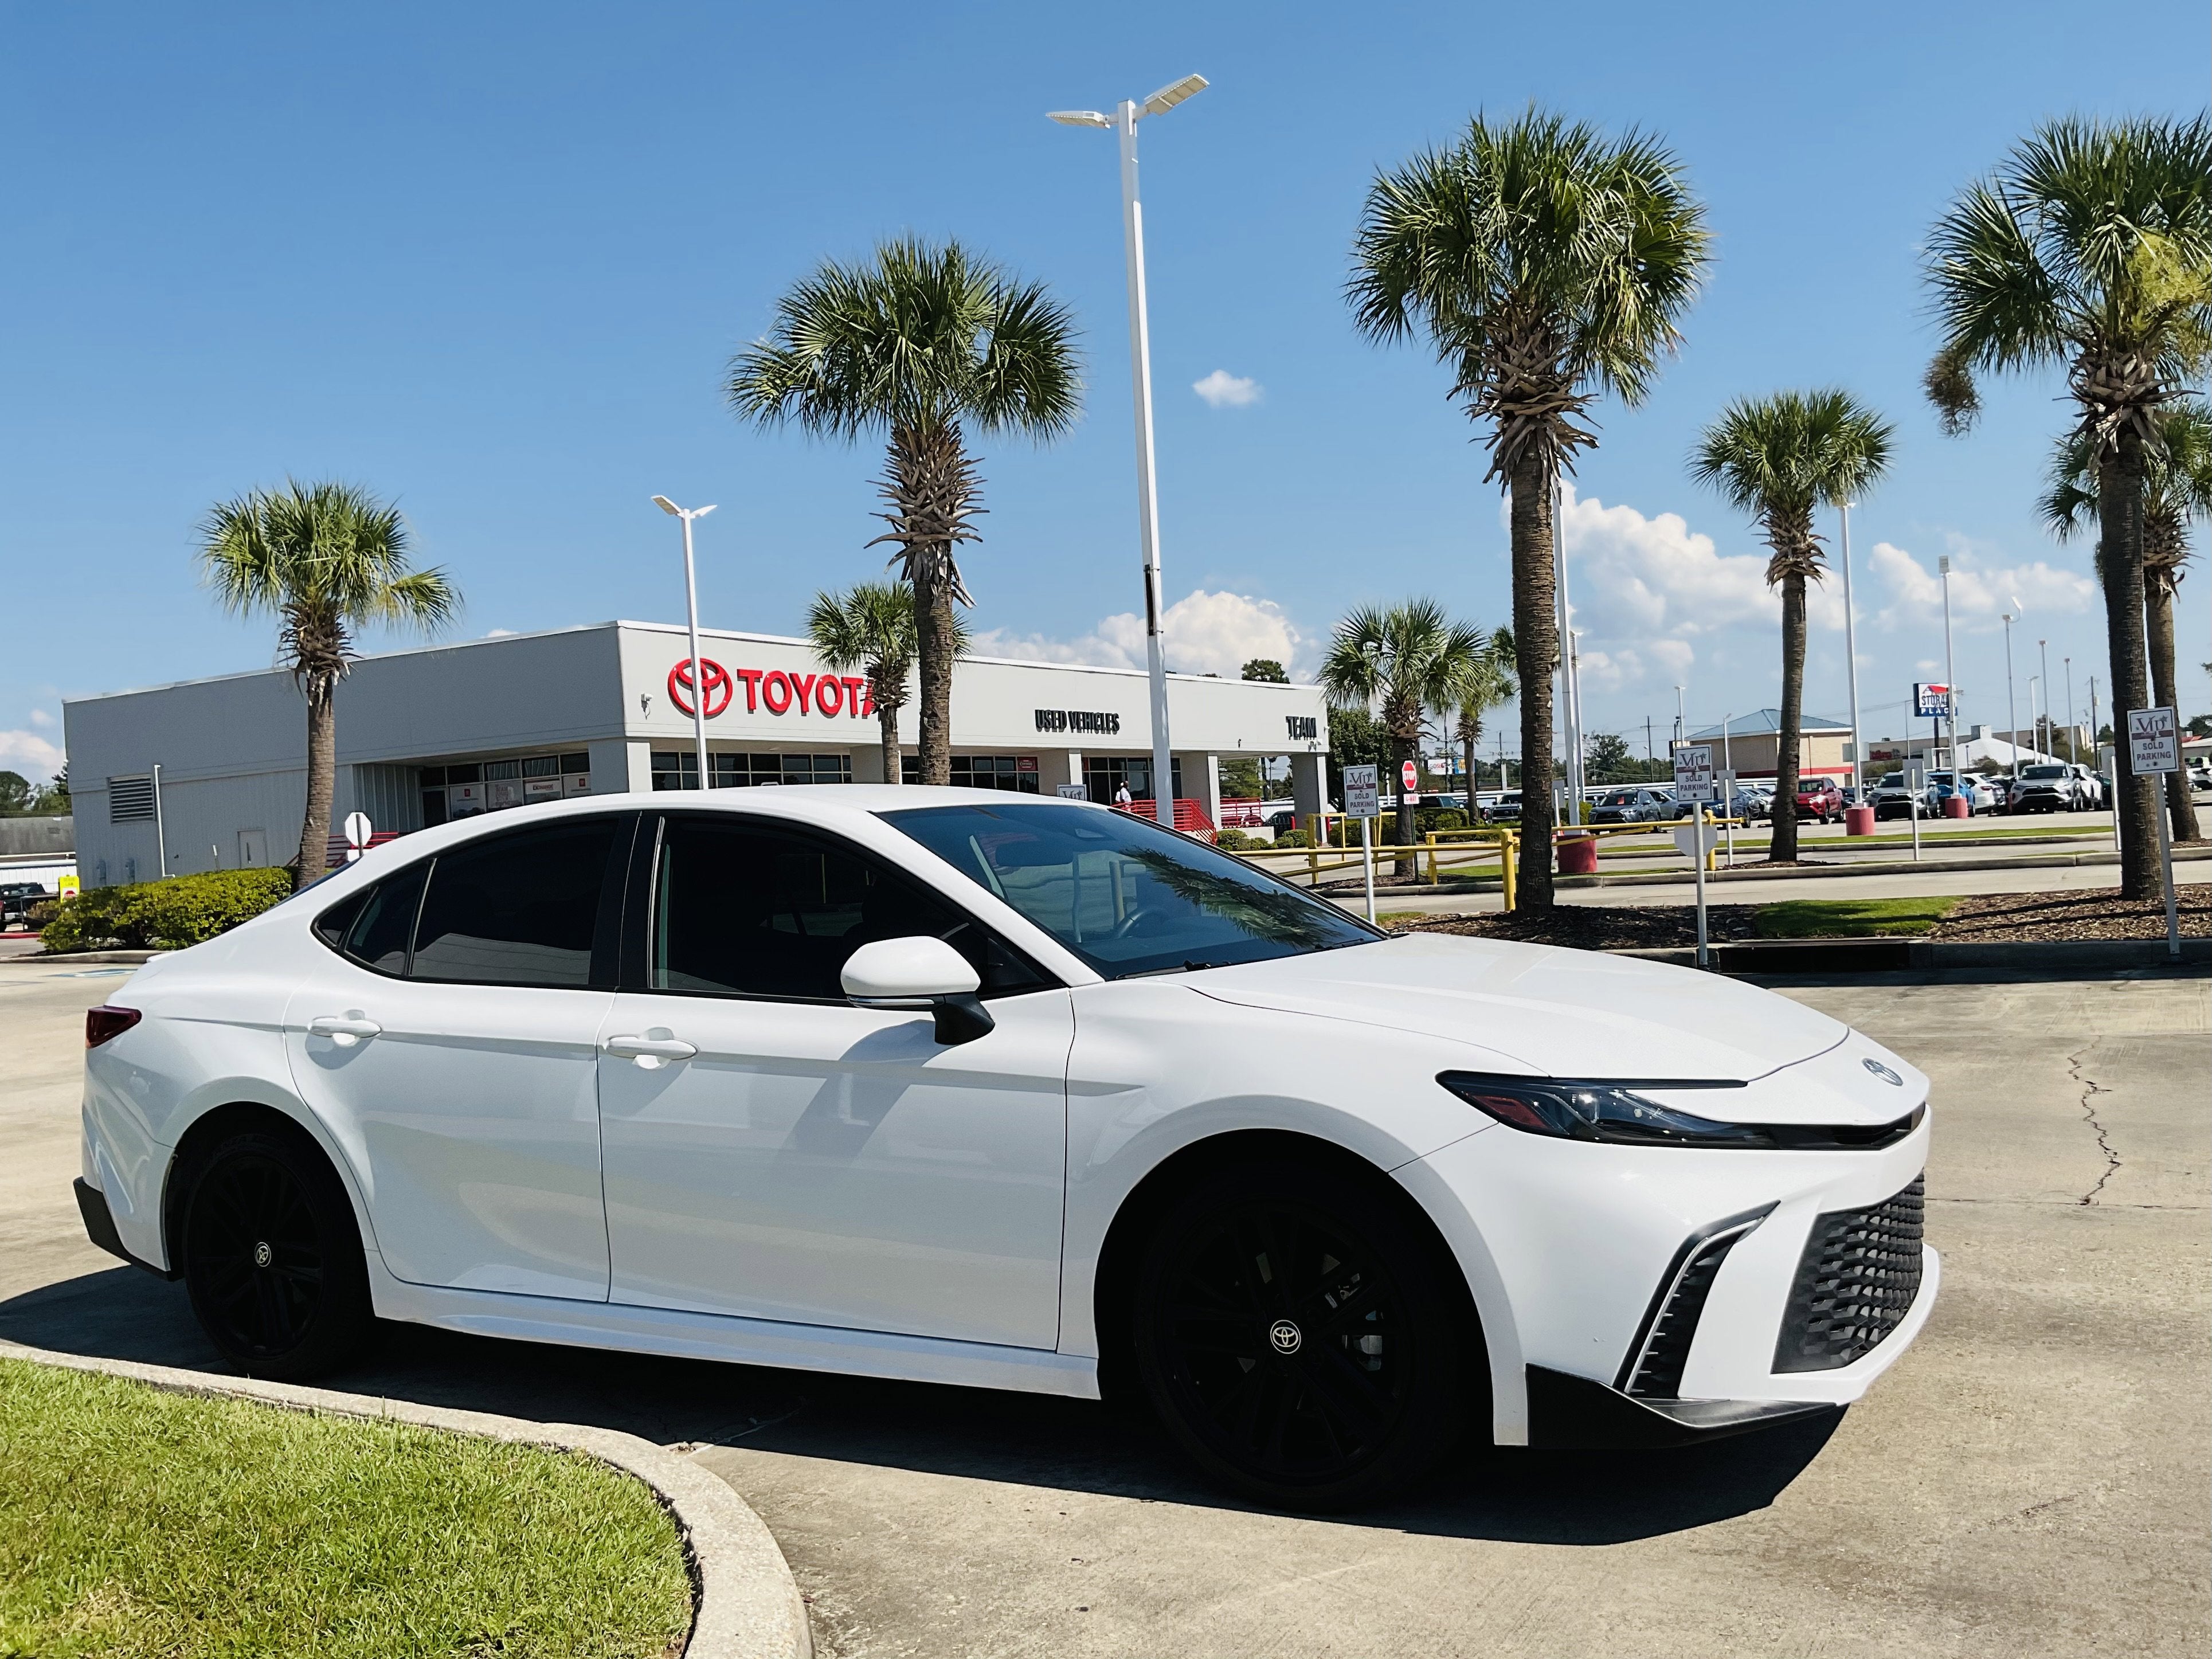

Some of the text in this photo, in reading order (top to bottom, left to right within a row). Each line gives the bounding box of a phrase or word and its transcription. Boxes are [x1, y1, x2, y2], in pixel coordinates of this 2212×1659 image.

[1035, 709, 1120, 733] USED VEHICLES
[1286, 715, 1317, 739] TEAM
[2143, 741, 2164, 750] SOLD
[2137, 751, 2171, 761] PARKING
[1403, 770, 1416, 780] STOP
[1680, 783, 1708, 792] PARKING
